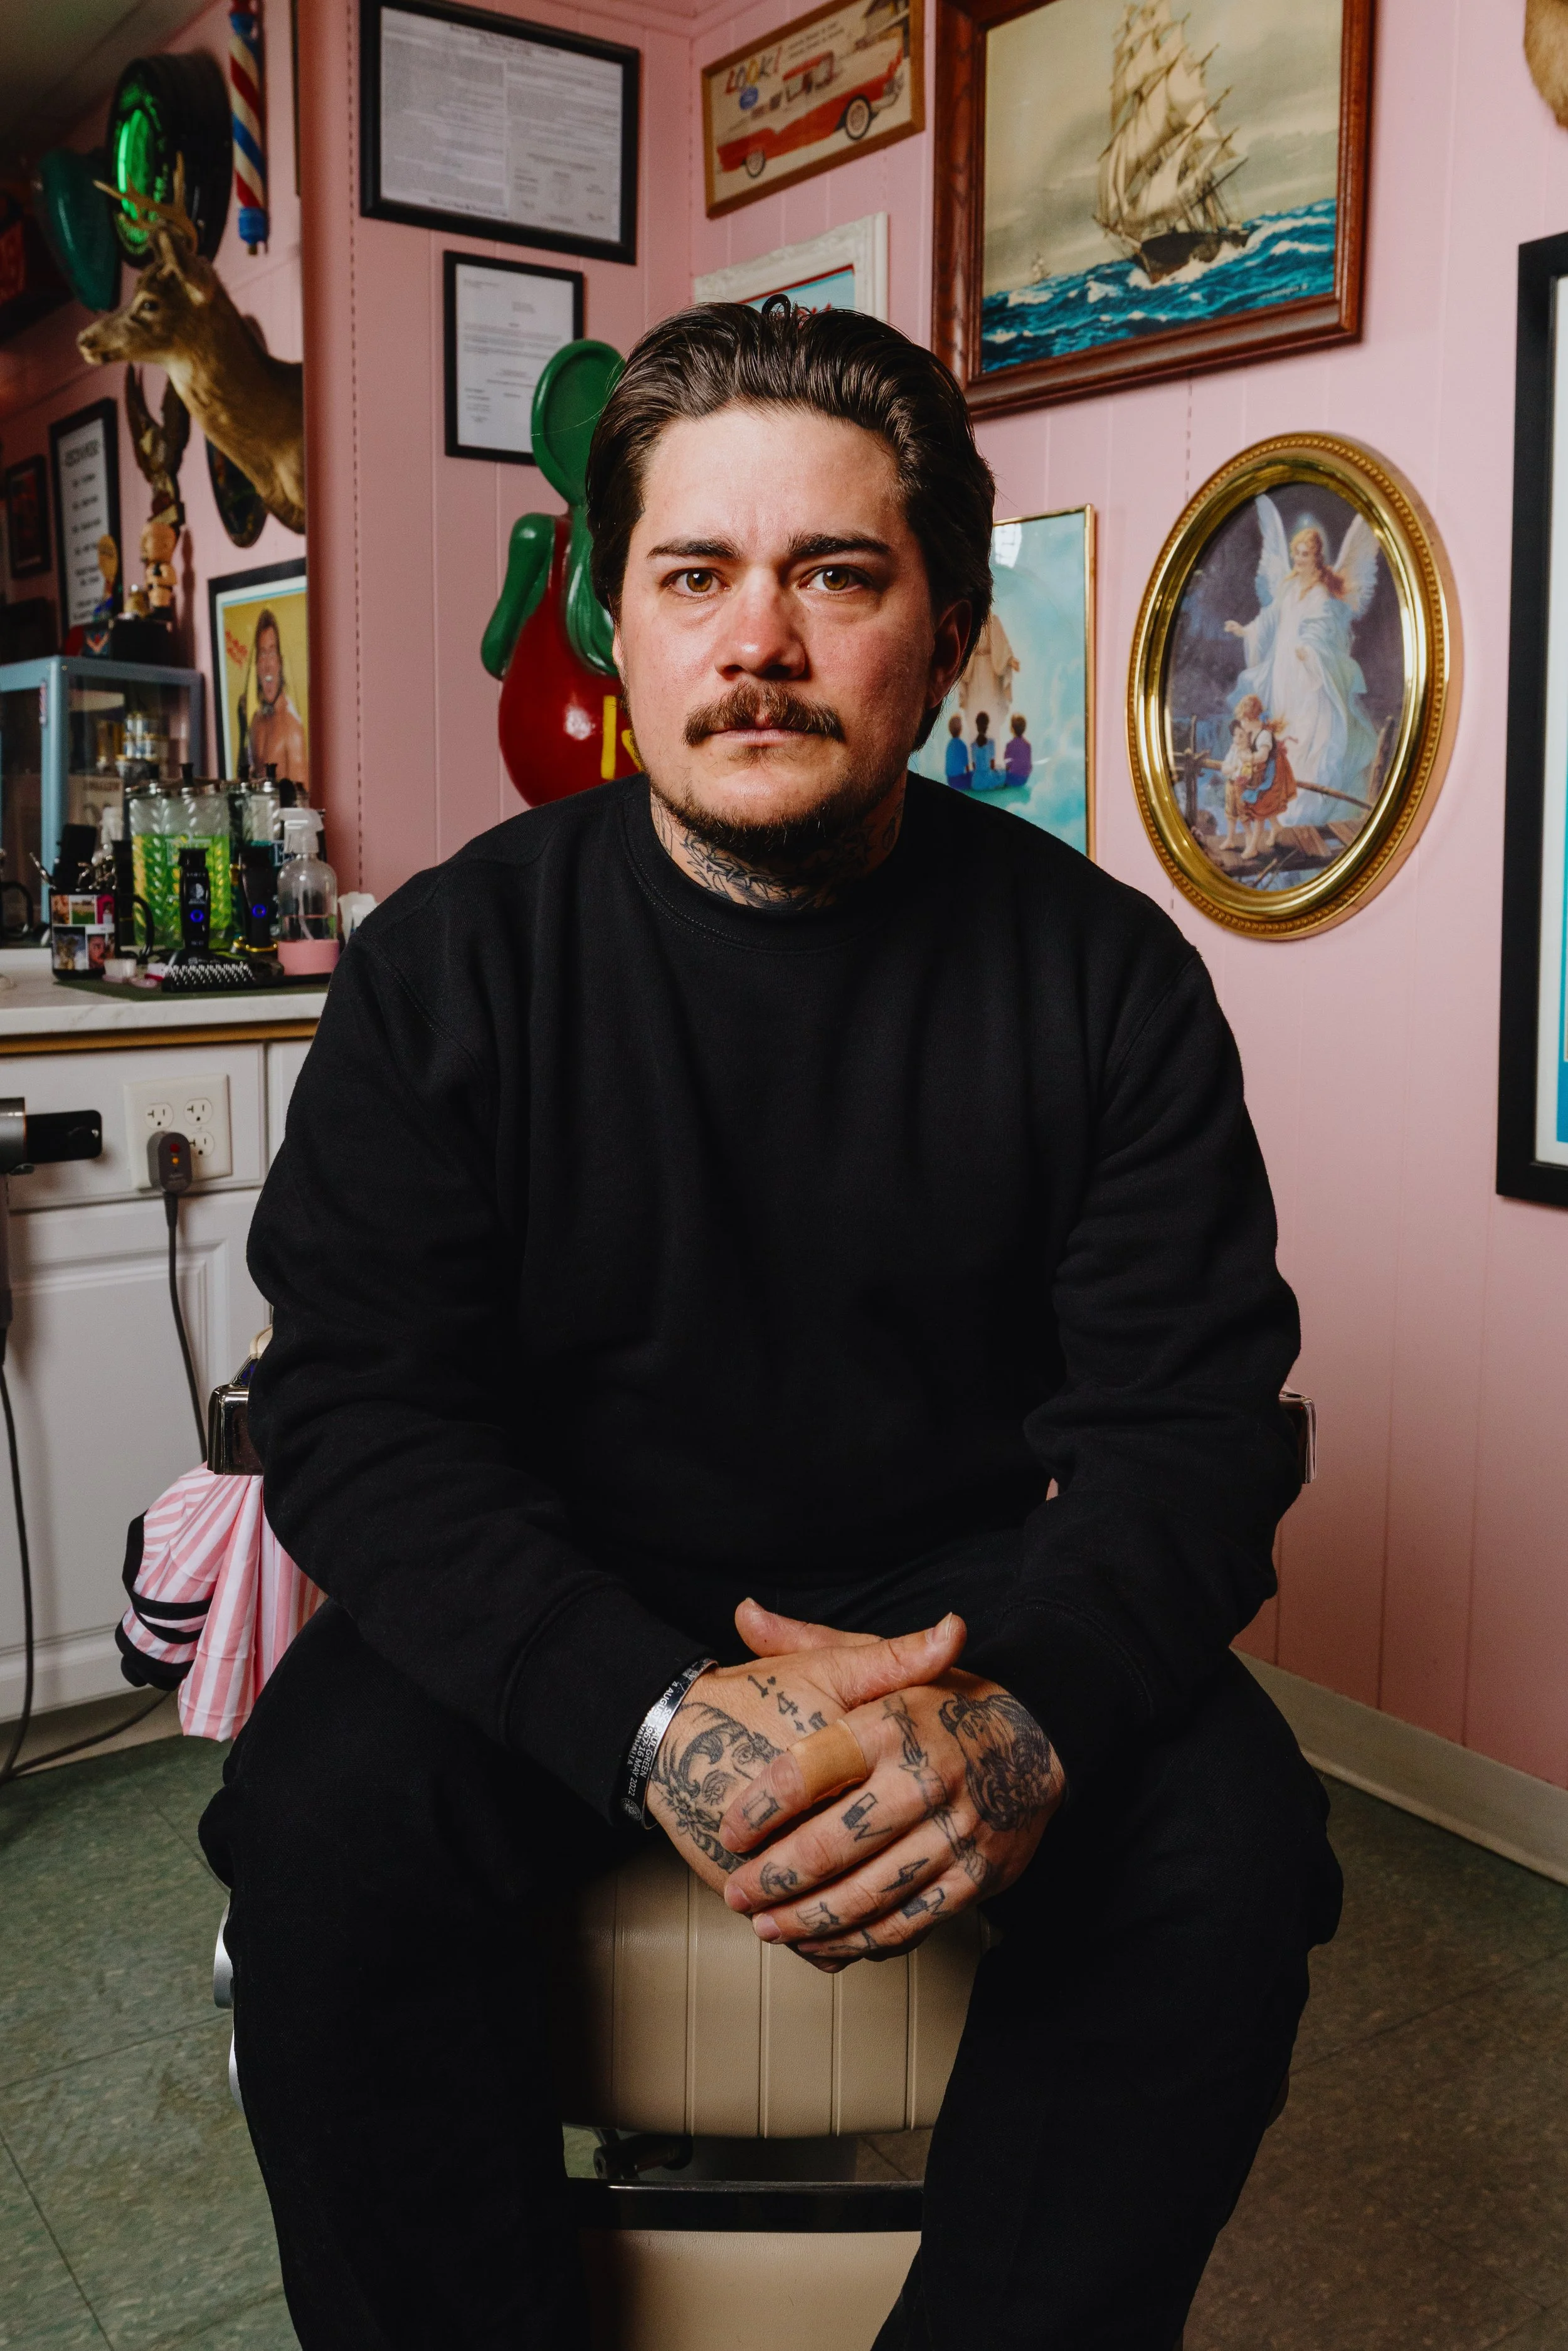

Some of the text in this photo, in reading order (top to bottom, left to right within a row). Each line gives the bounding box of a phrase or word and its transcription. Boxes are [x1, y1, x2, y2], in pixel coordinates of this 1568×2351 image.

[651, 1687, 674, 1722] AUGUST
[657, 1707, 672, 1724] SSG
[647, 1724, 663, 1748] PAUL
[632, 1757, 642, 1778] MAY
[639, 1749, 653, 1778] GREEN
[628, 1777, 637, 1796] 2022
